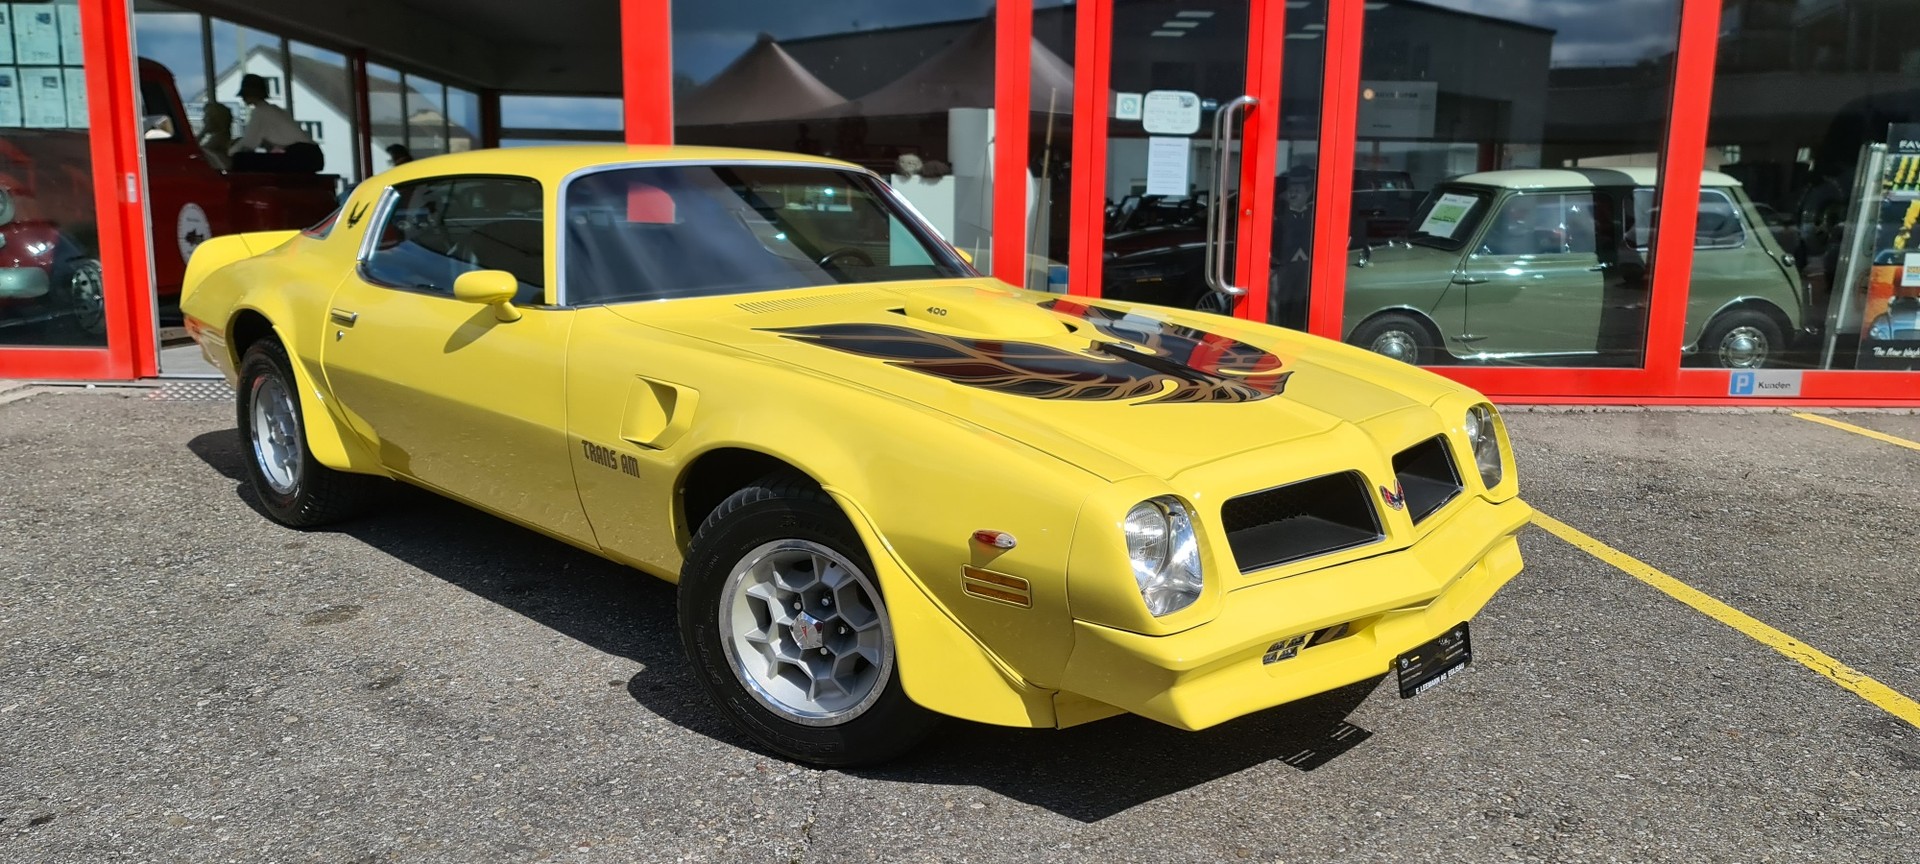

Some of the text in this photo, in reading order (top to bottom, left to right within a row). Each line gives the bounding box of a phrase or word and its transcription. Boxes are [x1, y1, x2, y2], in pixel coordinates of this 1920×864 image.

[926, 306, 947, 316] 400
[1735, 374, 1791, 393] P Kunden
[581, 439, 640, 479] TRANS AM
